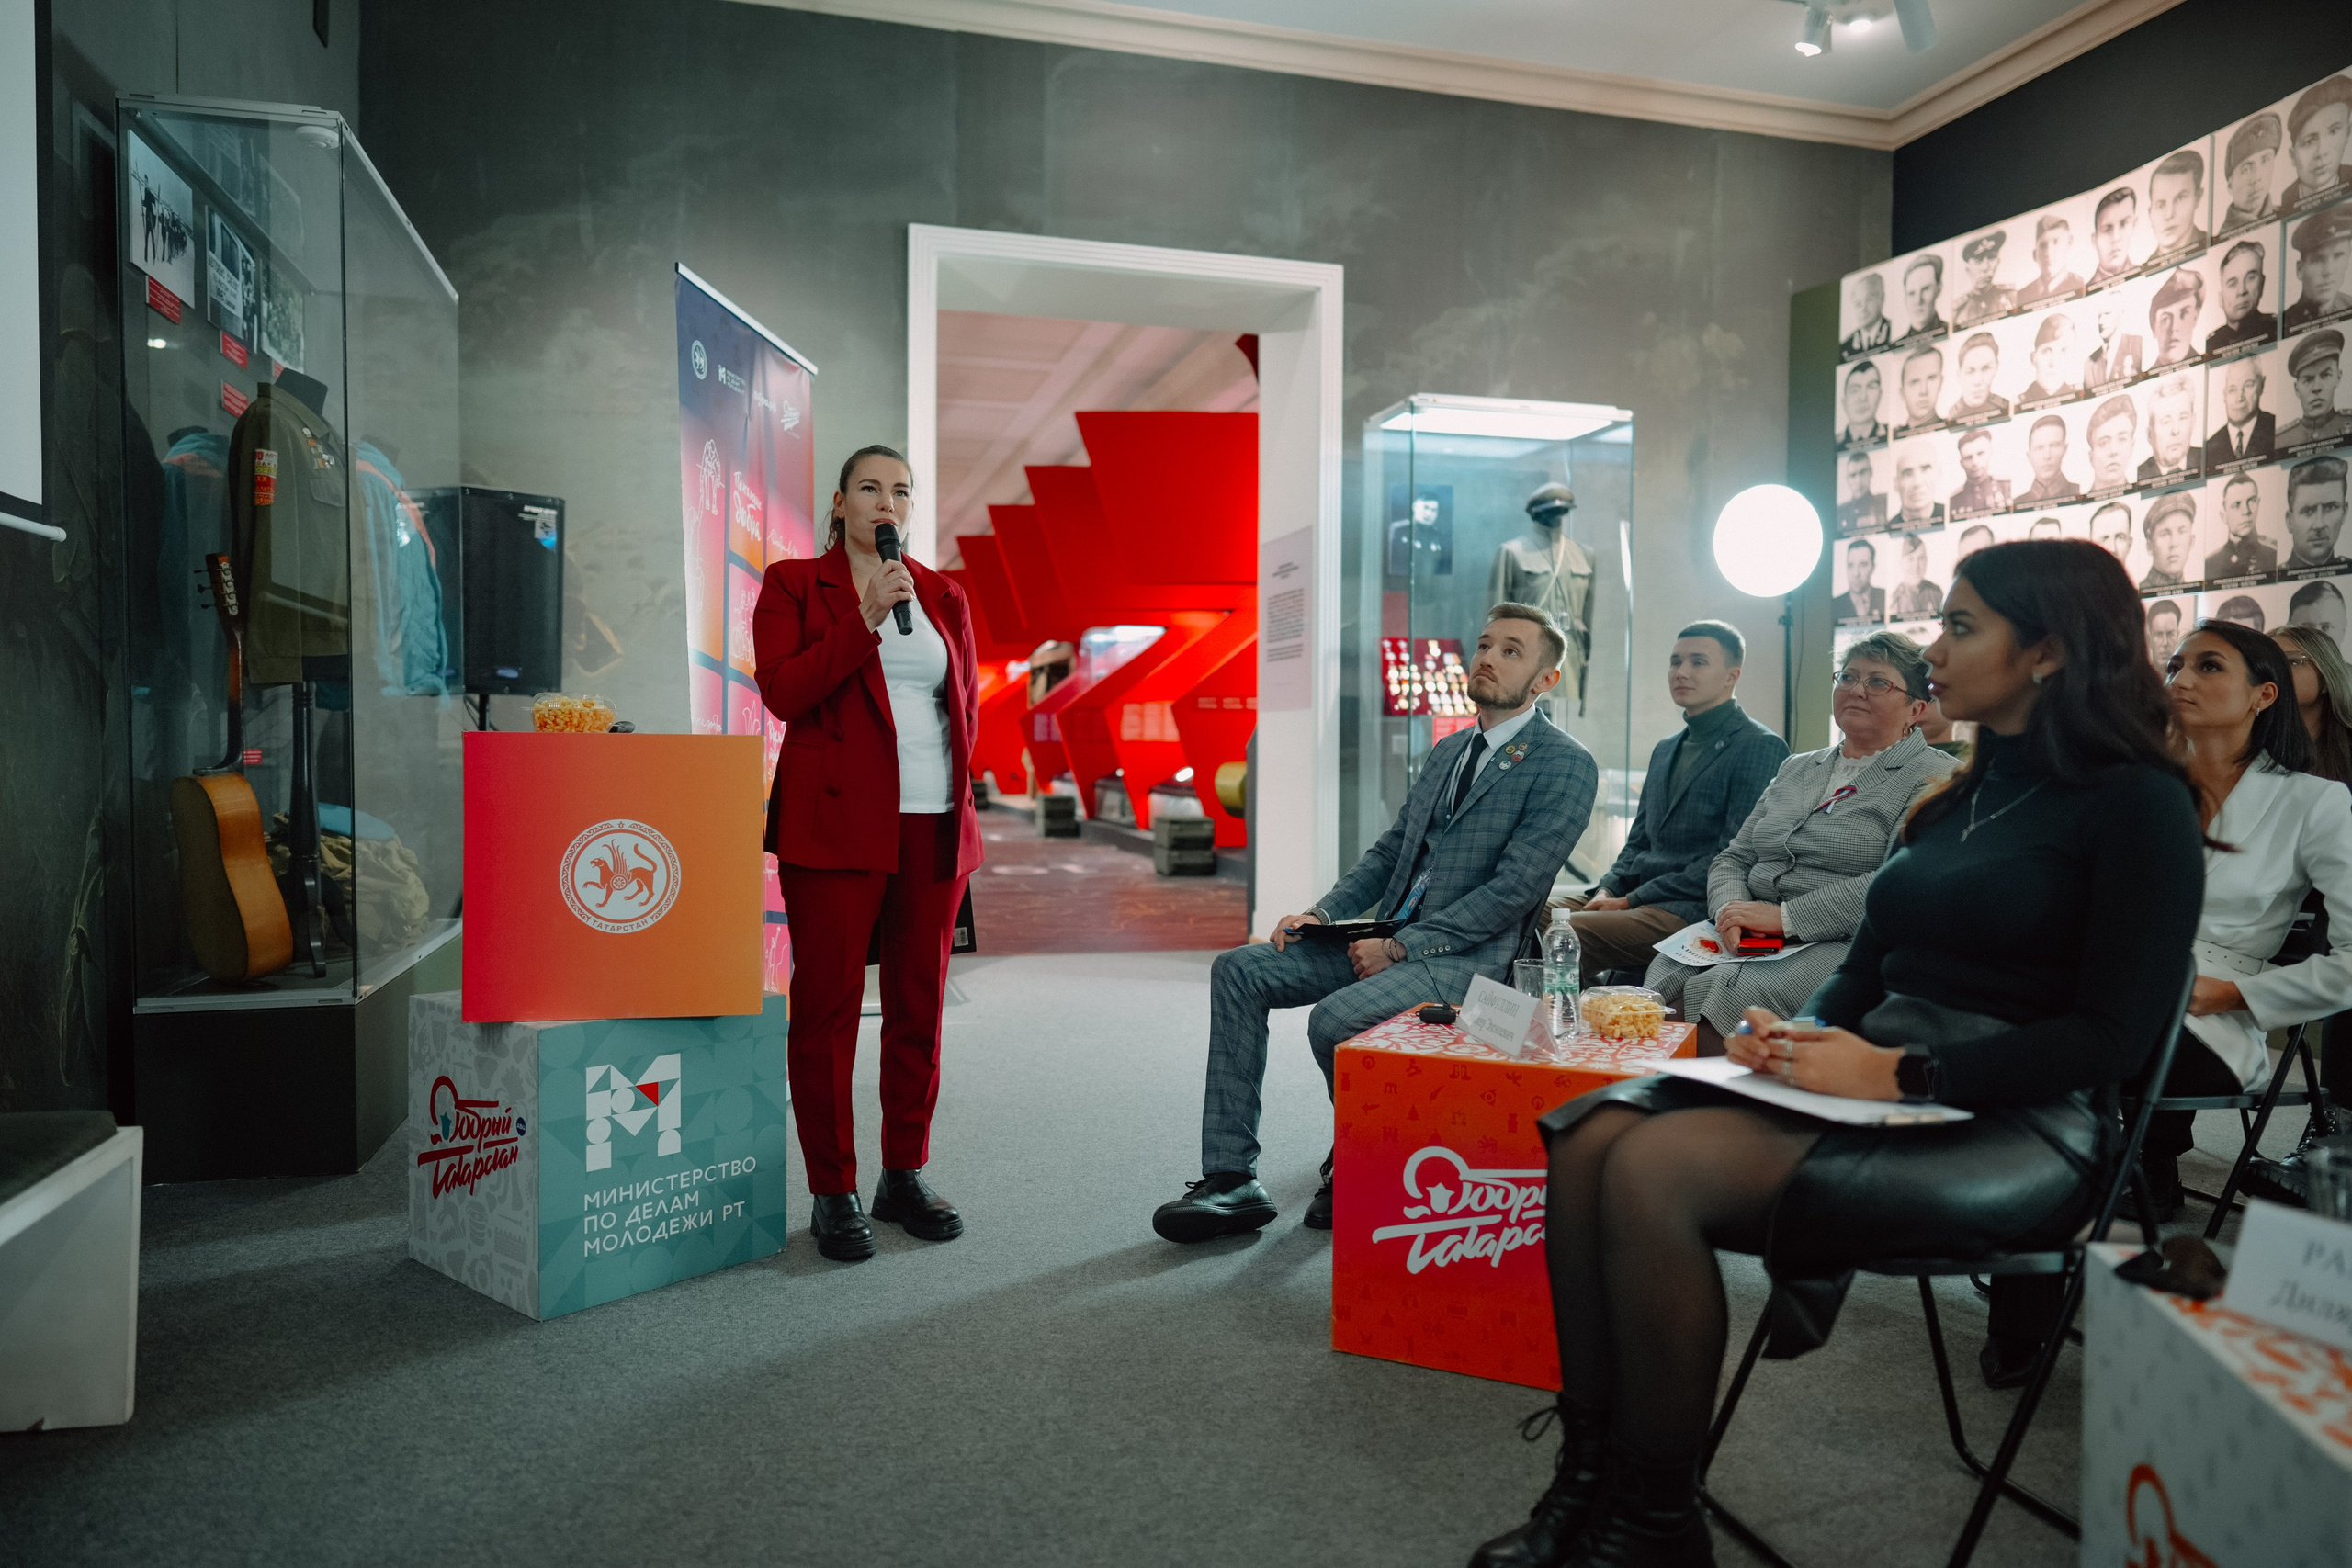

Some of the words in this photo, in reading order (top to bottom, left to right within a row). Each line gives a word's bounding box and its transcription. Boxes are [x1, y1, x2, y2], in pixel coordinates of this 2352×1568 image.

[592, 919, 649, 932] ТАТАРСТАН
[429, 1075, 513, 1154] Добрый
[417, 1136, 519, 1200] Татарстан
[582, 1156, 757, 1212] МИНИСТЕРСТВО
[1402, 1145, 1548, 1224] Добр
[582, 1211, 617, 1235] ПО
[624, 1191, 700, 1226] ДЕЛАМ
[582, 1211, 714, 1258] МОЛОДЕЖИ
[722, 1201, 746, 1222] РТ
[1372, 1213, 1547, 1274] Татарс
[2301, 1237, 2352, 1280] РА
